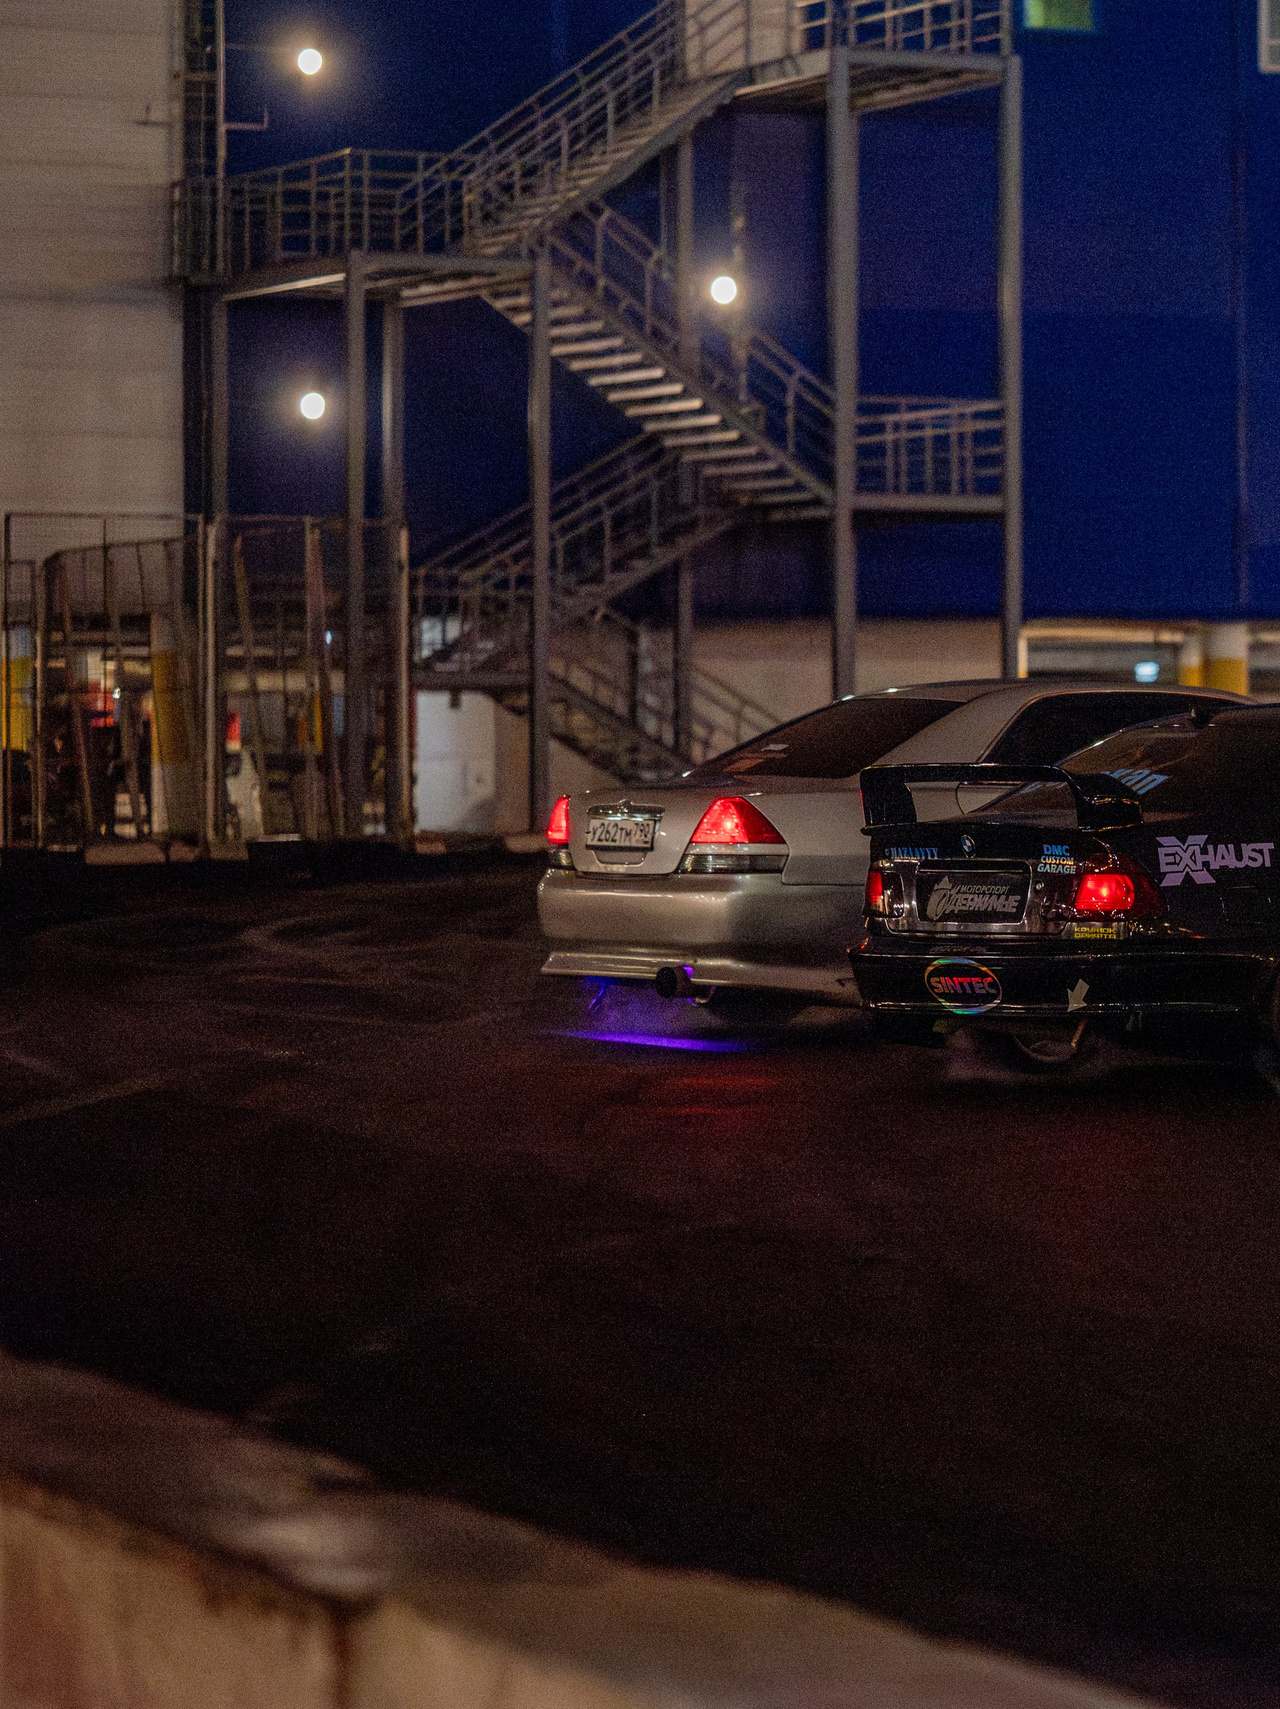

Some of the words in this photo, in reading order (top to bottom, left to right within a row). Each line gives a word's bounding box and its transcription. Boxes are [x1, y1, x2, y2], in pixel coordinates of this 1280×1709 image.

[1042, 844, 1070, 856] DMC
[1041, 855, 1074, 865] CUSTOM
[1156, 834, 1275, 887] EXHAUST
[1037, 863, 1077, 874] GARAGE
[929, 976, 999, 994] SINTEC
